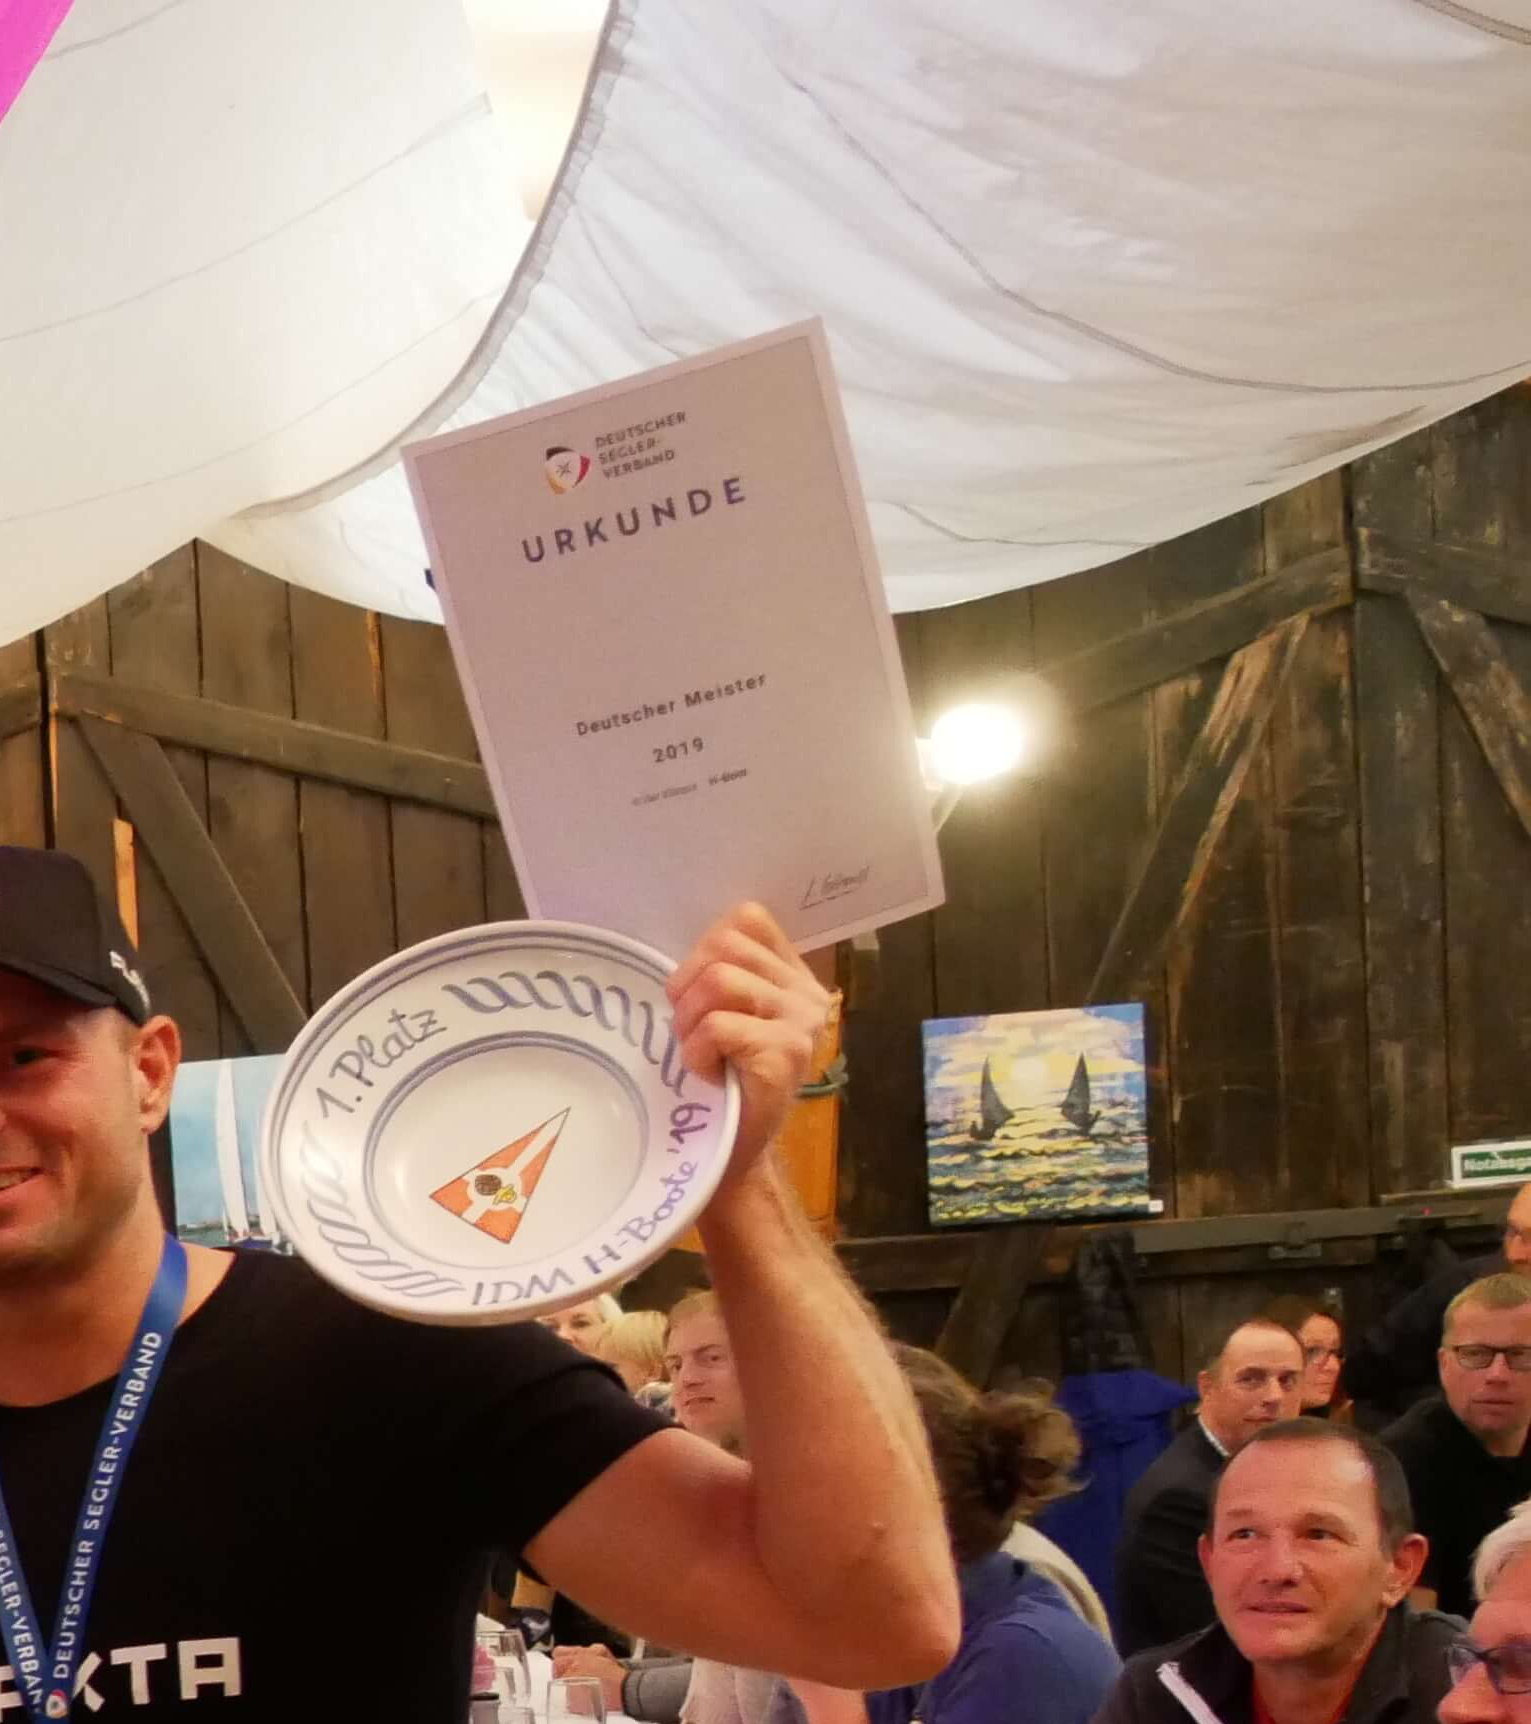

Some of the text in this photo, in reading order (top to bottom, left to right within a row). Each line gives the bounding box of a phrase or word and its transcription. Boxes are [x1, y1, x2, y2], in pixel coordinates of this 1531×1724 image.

[595, 411, 687, 449] DEUTSCHER
[602, 449, 675, 479] VERBAND
[521, 477, 747, 564] URKUNDE
[576, 673, 768, 736] Deutscher Meister
[652, 738, 705, 765] 2019
[470, 1264, 573, 1308] IDM
[583, 1158, 697, 1277] H-Boote
[54, 1330, 163, 1680] DEUTSCHER SEGLER-VERBAND
